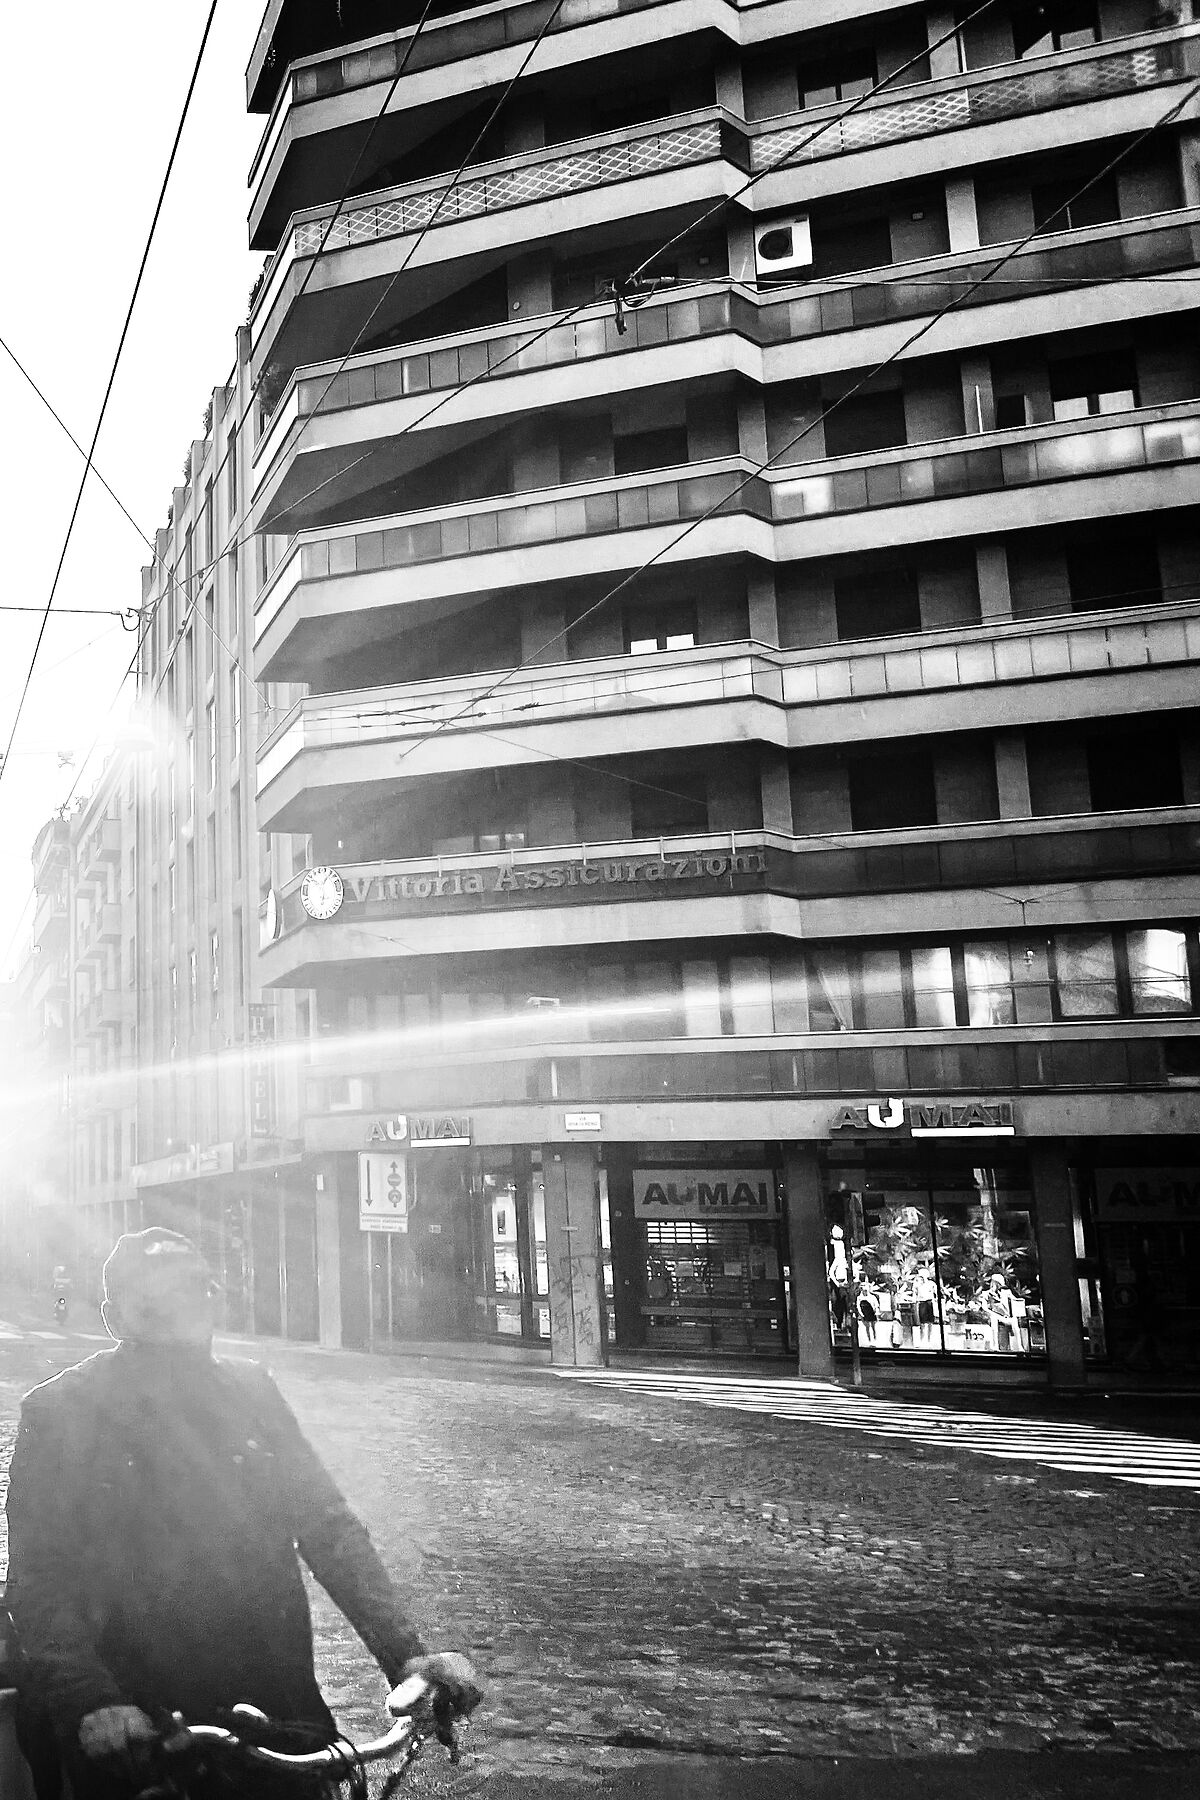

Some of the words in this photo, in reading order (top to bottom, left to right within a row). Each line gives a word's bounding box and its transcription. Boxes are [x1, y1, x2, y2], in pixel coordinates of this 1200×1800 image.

[347, 870, 484, 902] Vittoria
[494, 850, 769, 892] Assicurazioni
[249, 1014, 267, 1120] HTEL
[365, 1114, 471, 1142] AUMAI
[831, 1097, 1014, 1129] AUMAI
[642, 1182, 768, 1206] AUMAI
